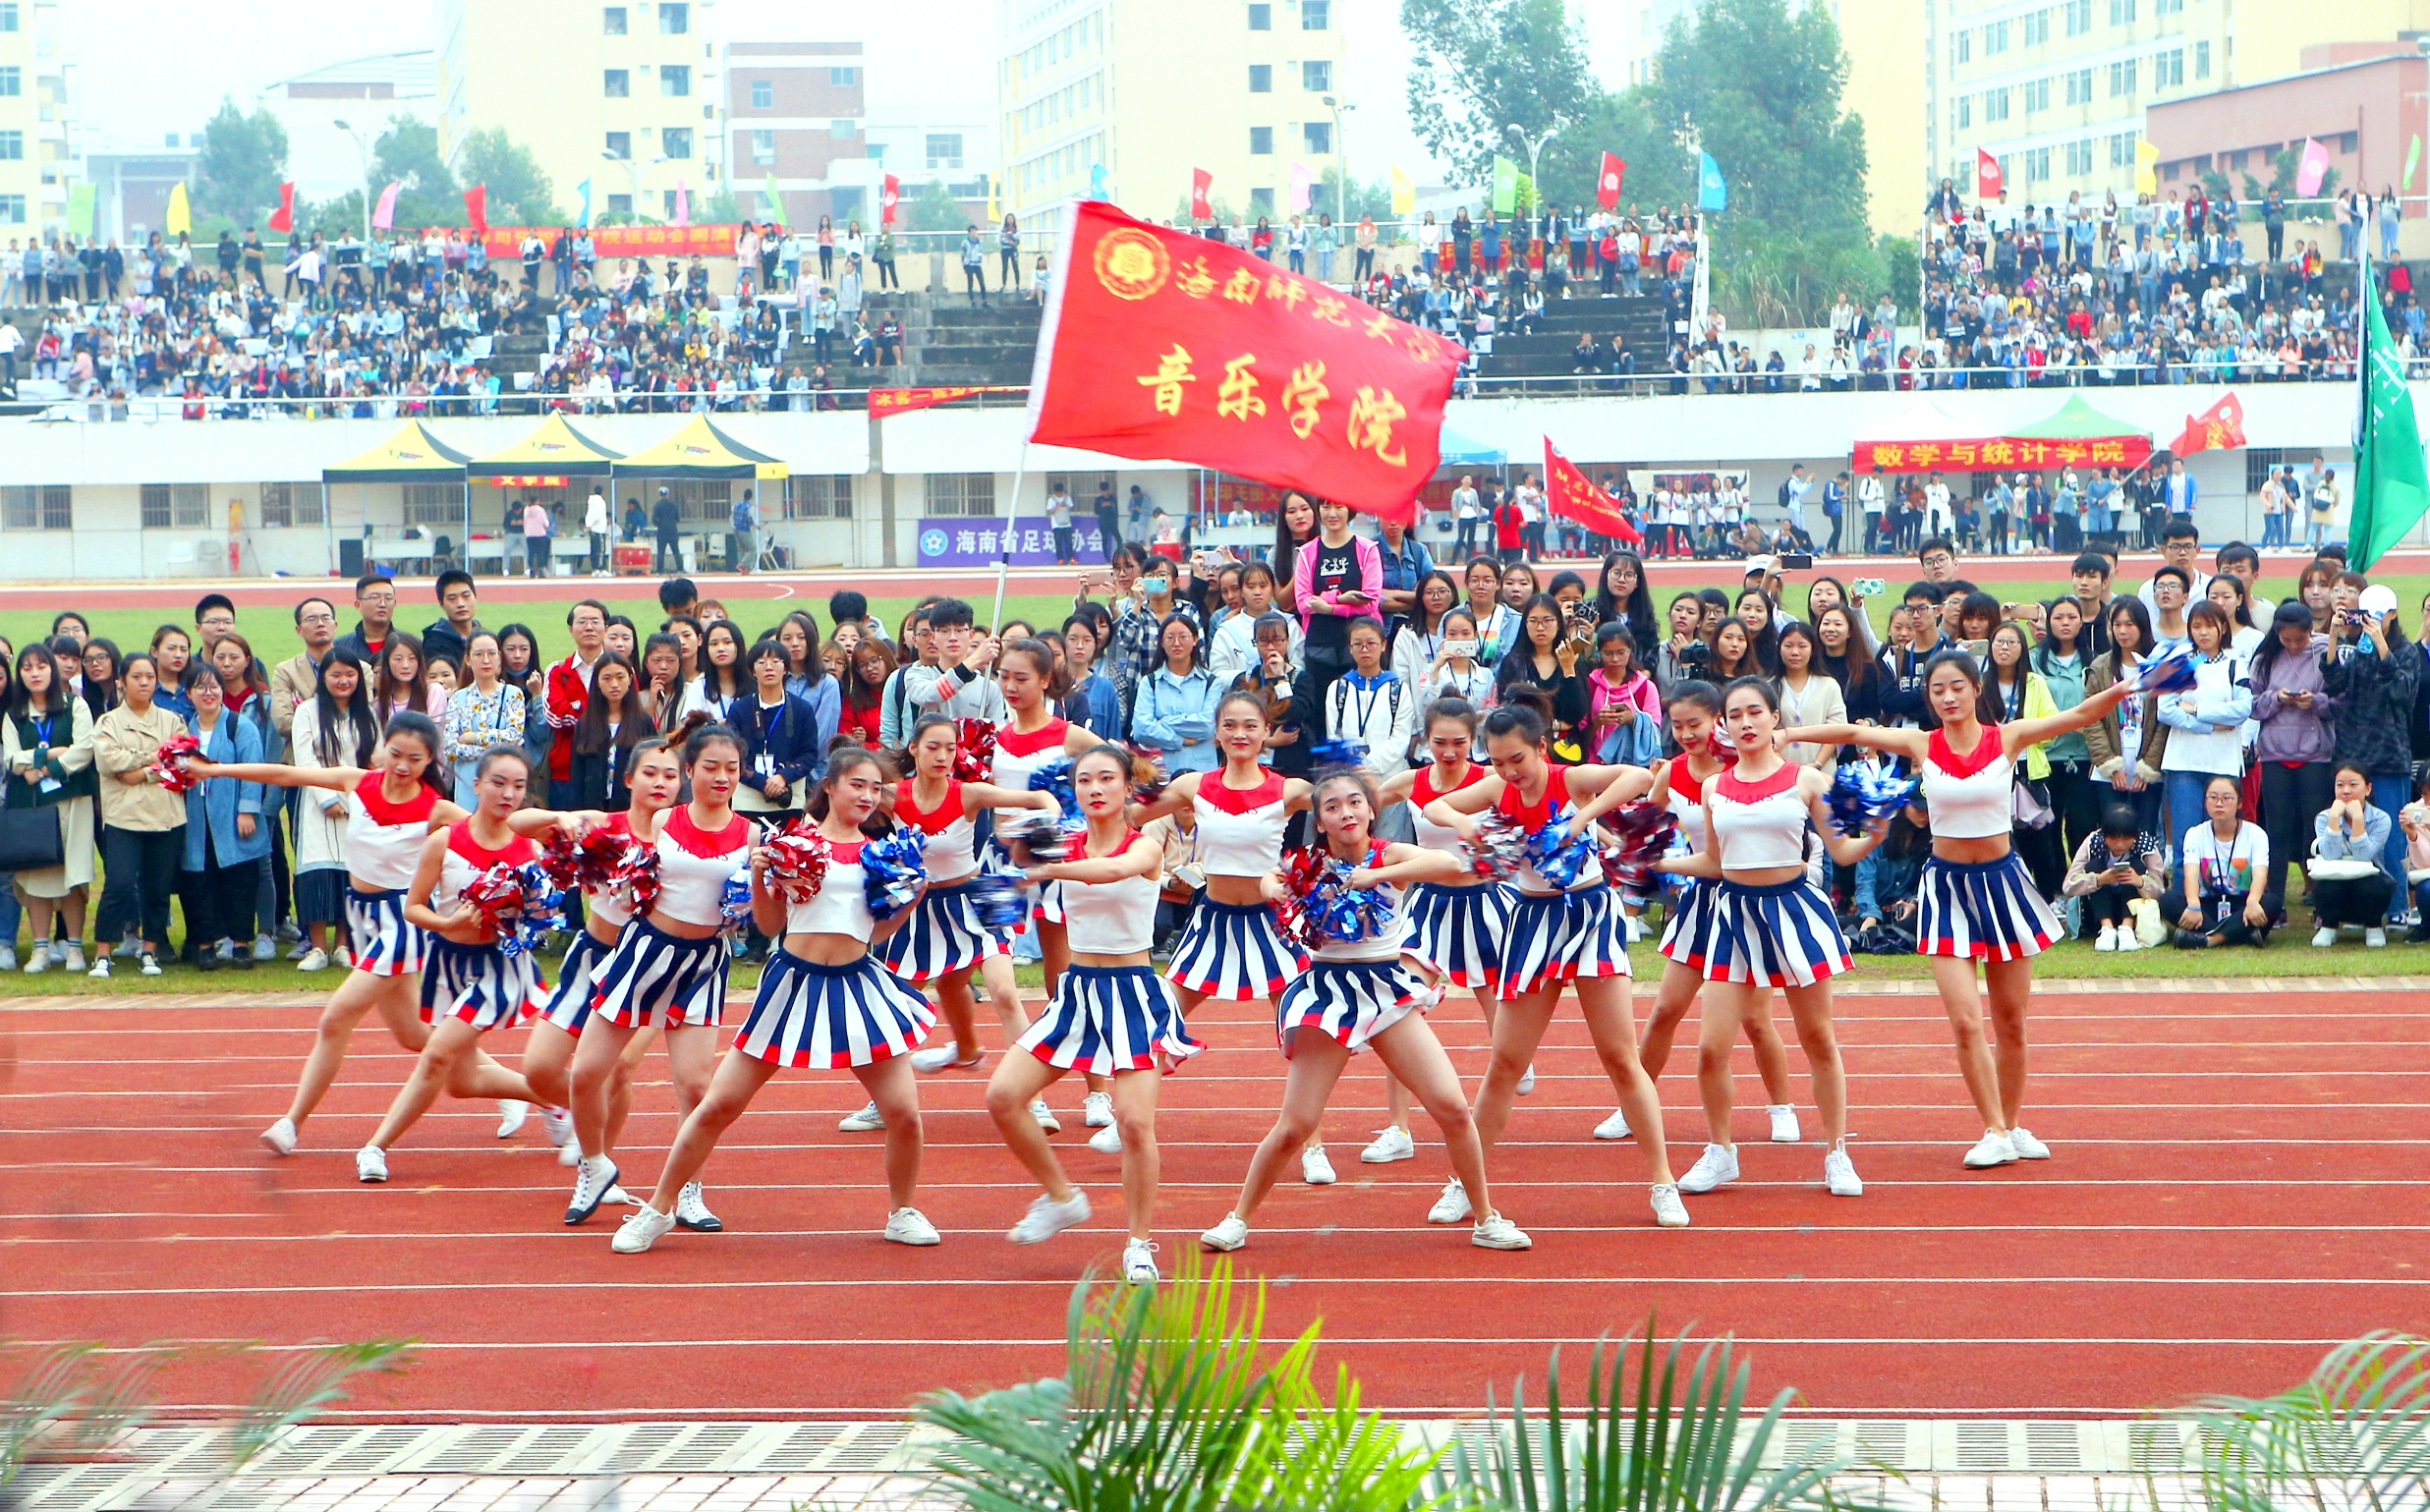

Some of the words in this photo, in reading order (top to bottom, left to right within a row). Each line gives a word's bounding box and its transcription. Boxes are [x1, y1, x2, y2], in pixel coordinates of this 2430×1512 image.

[1136, 342, 1408, 468] 音乐学院
[1873, 440, 2126, 468] 数学与统计学院
